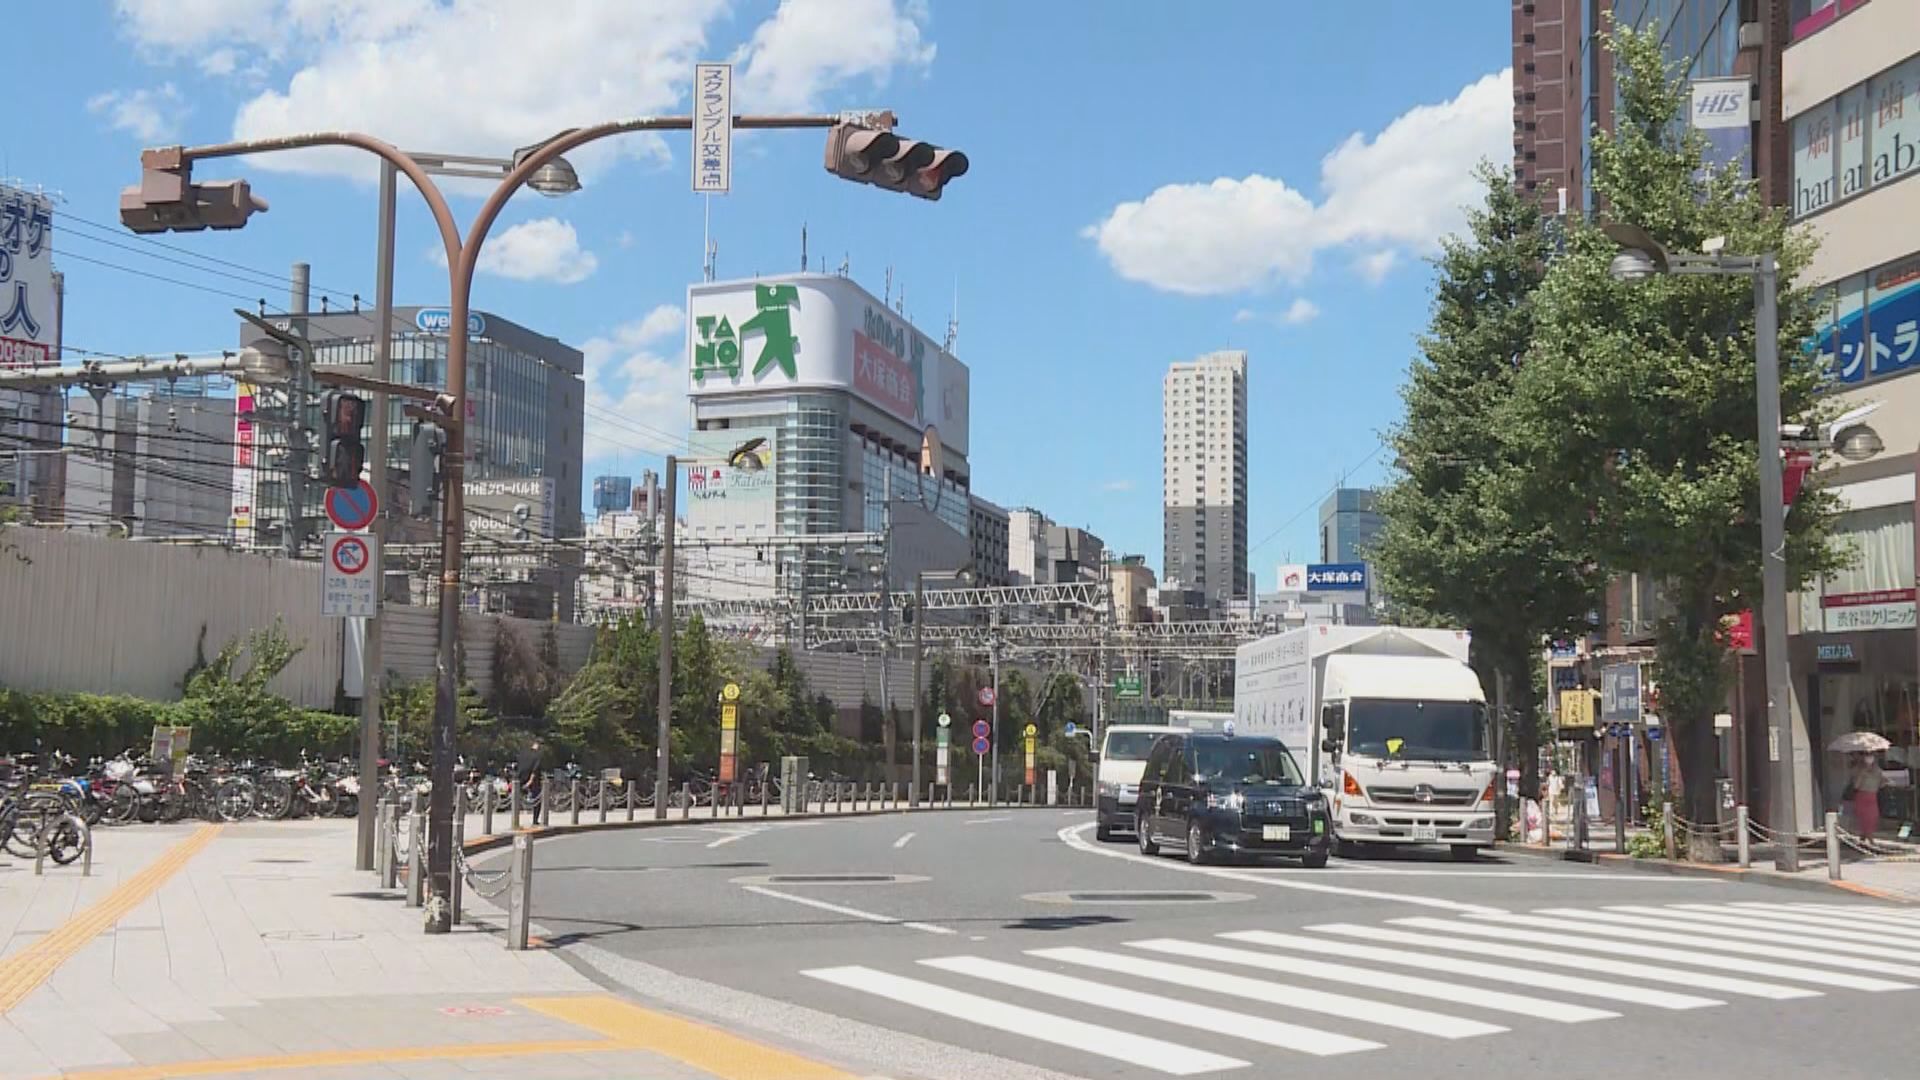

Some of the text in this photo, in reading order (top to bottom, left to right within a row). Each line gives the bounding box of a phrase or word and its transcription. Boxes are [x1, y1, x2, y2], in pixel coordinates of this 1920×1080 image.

[1695, 94, 1744, 114] HIS
[702, 69, 723, 187] スクランブル交差点
[858, 350, 912, 404] 大塚商会
[463, 481, 540, 495] THEグローバル社
[1308, 570, 1364, 584] 大塚商会
[1837, 608, 1916, 628] 渋谷クリニック
